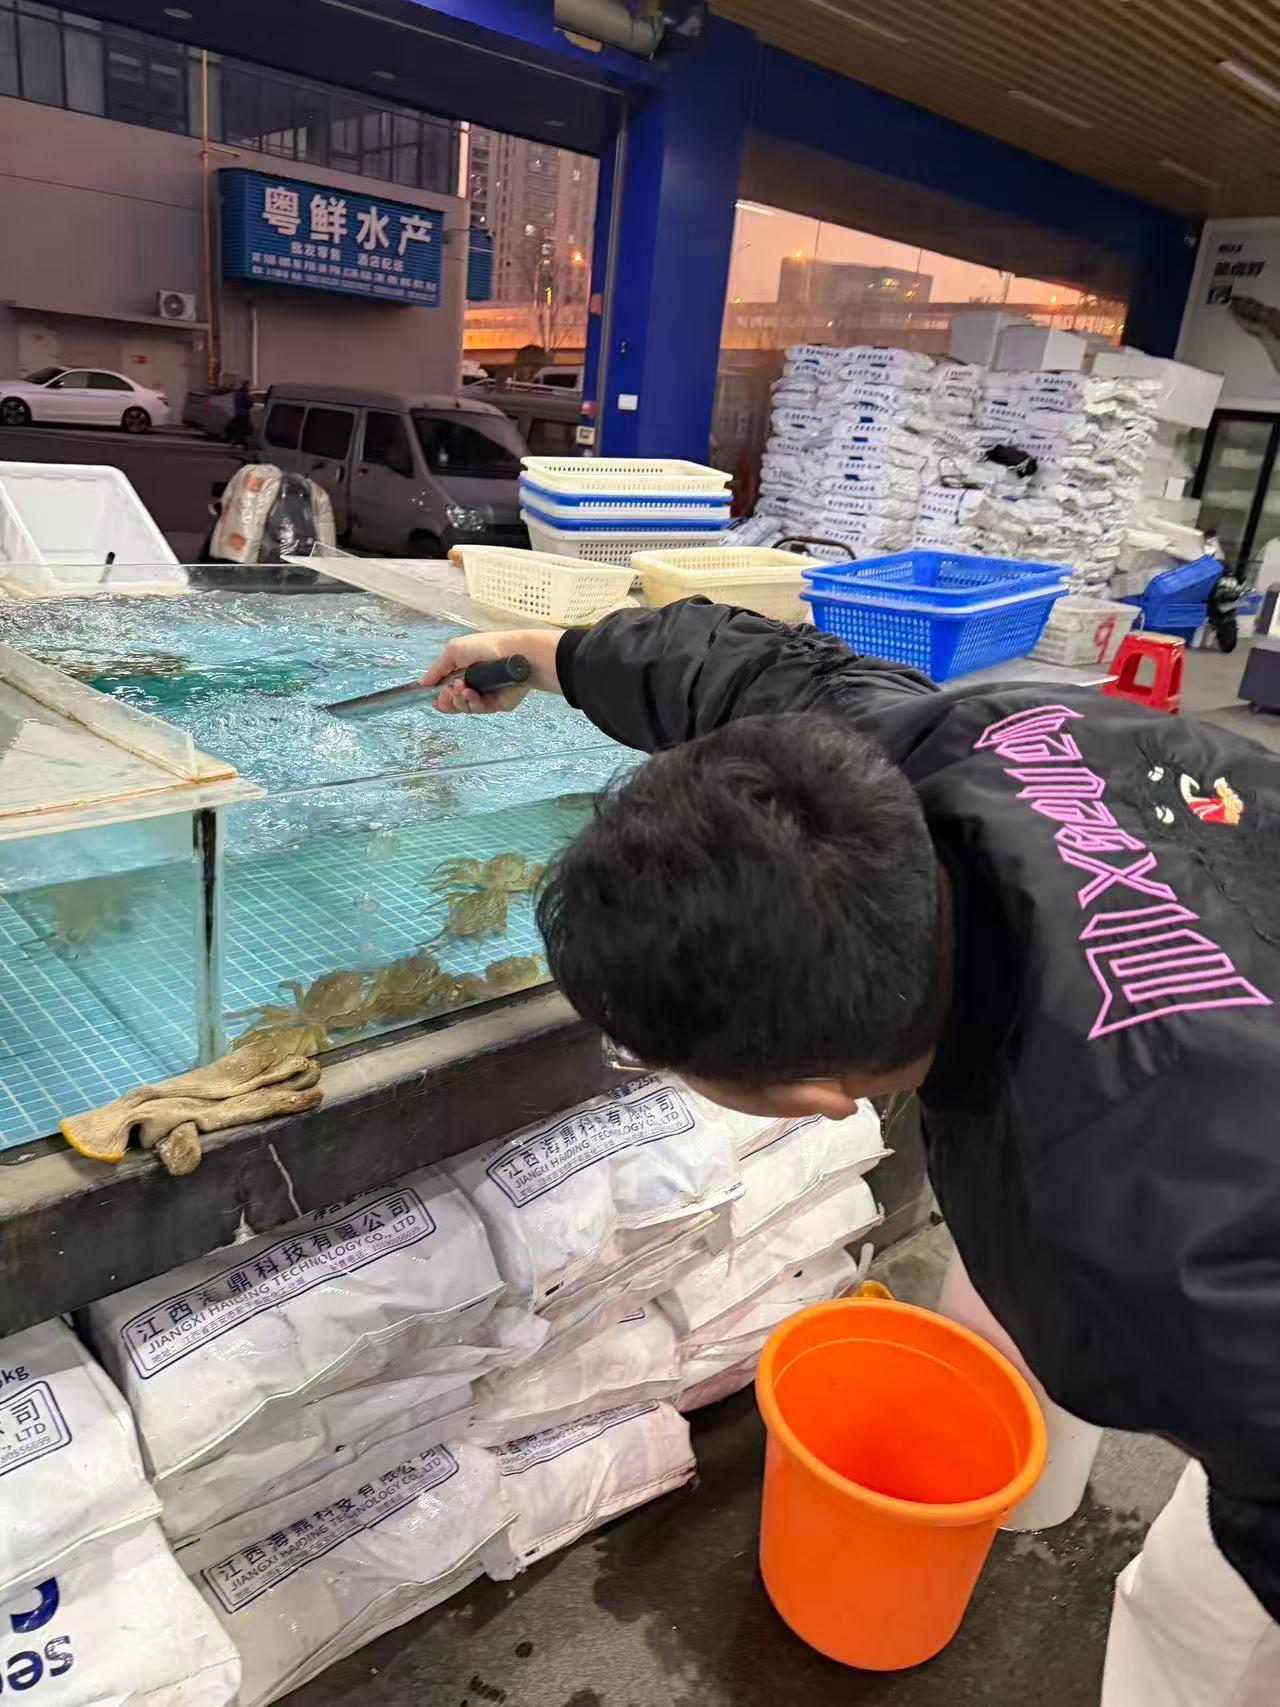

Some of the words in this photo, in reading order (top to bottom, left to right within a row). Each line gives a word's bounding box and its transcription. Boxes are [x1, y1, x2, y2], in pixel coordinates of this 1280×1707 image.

[263, 186, 433, 256] 粤鲜水产
[502, 1094, 674, 1179] 江西海鼎科有公司
[590, 1119, 649, 1144] TECLOGY
[148, 1310, 208, 1354] JIANGXI
[272, 1238, 362, 1287] TECHNOLOGY
[392, 1214, 416, 1234] LTD
[0, 1365, 29, 1387] kg
[15, 1422, 46, 1443] LTD
[231, 1555, 278, 1592] JIANGXI
